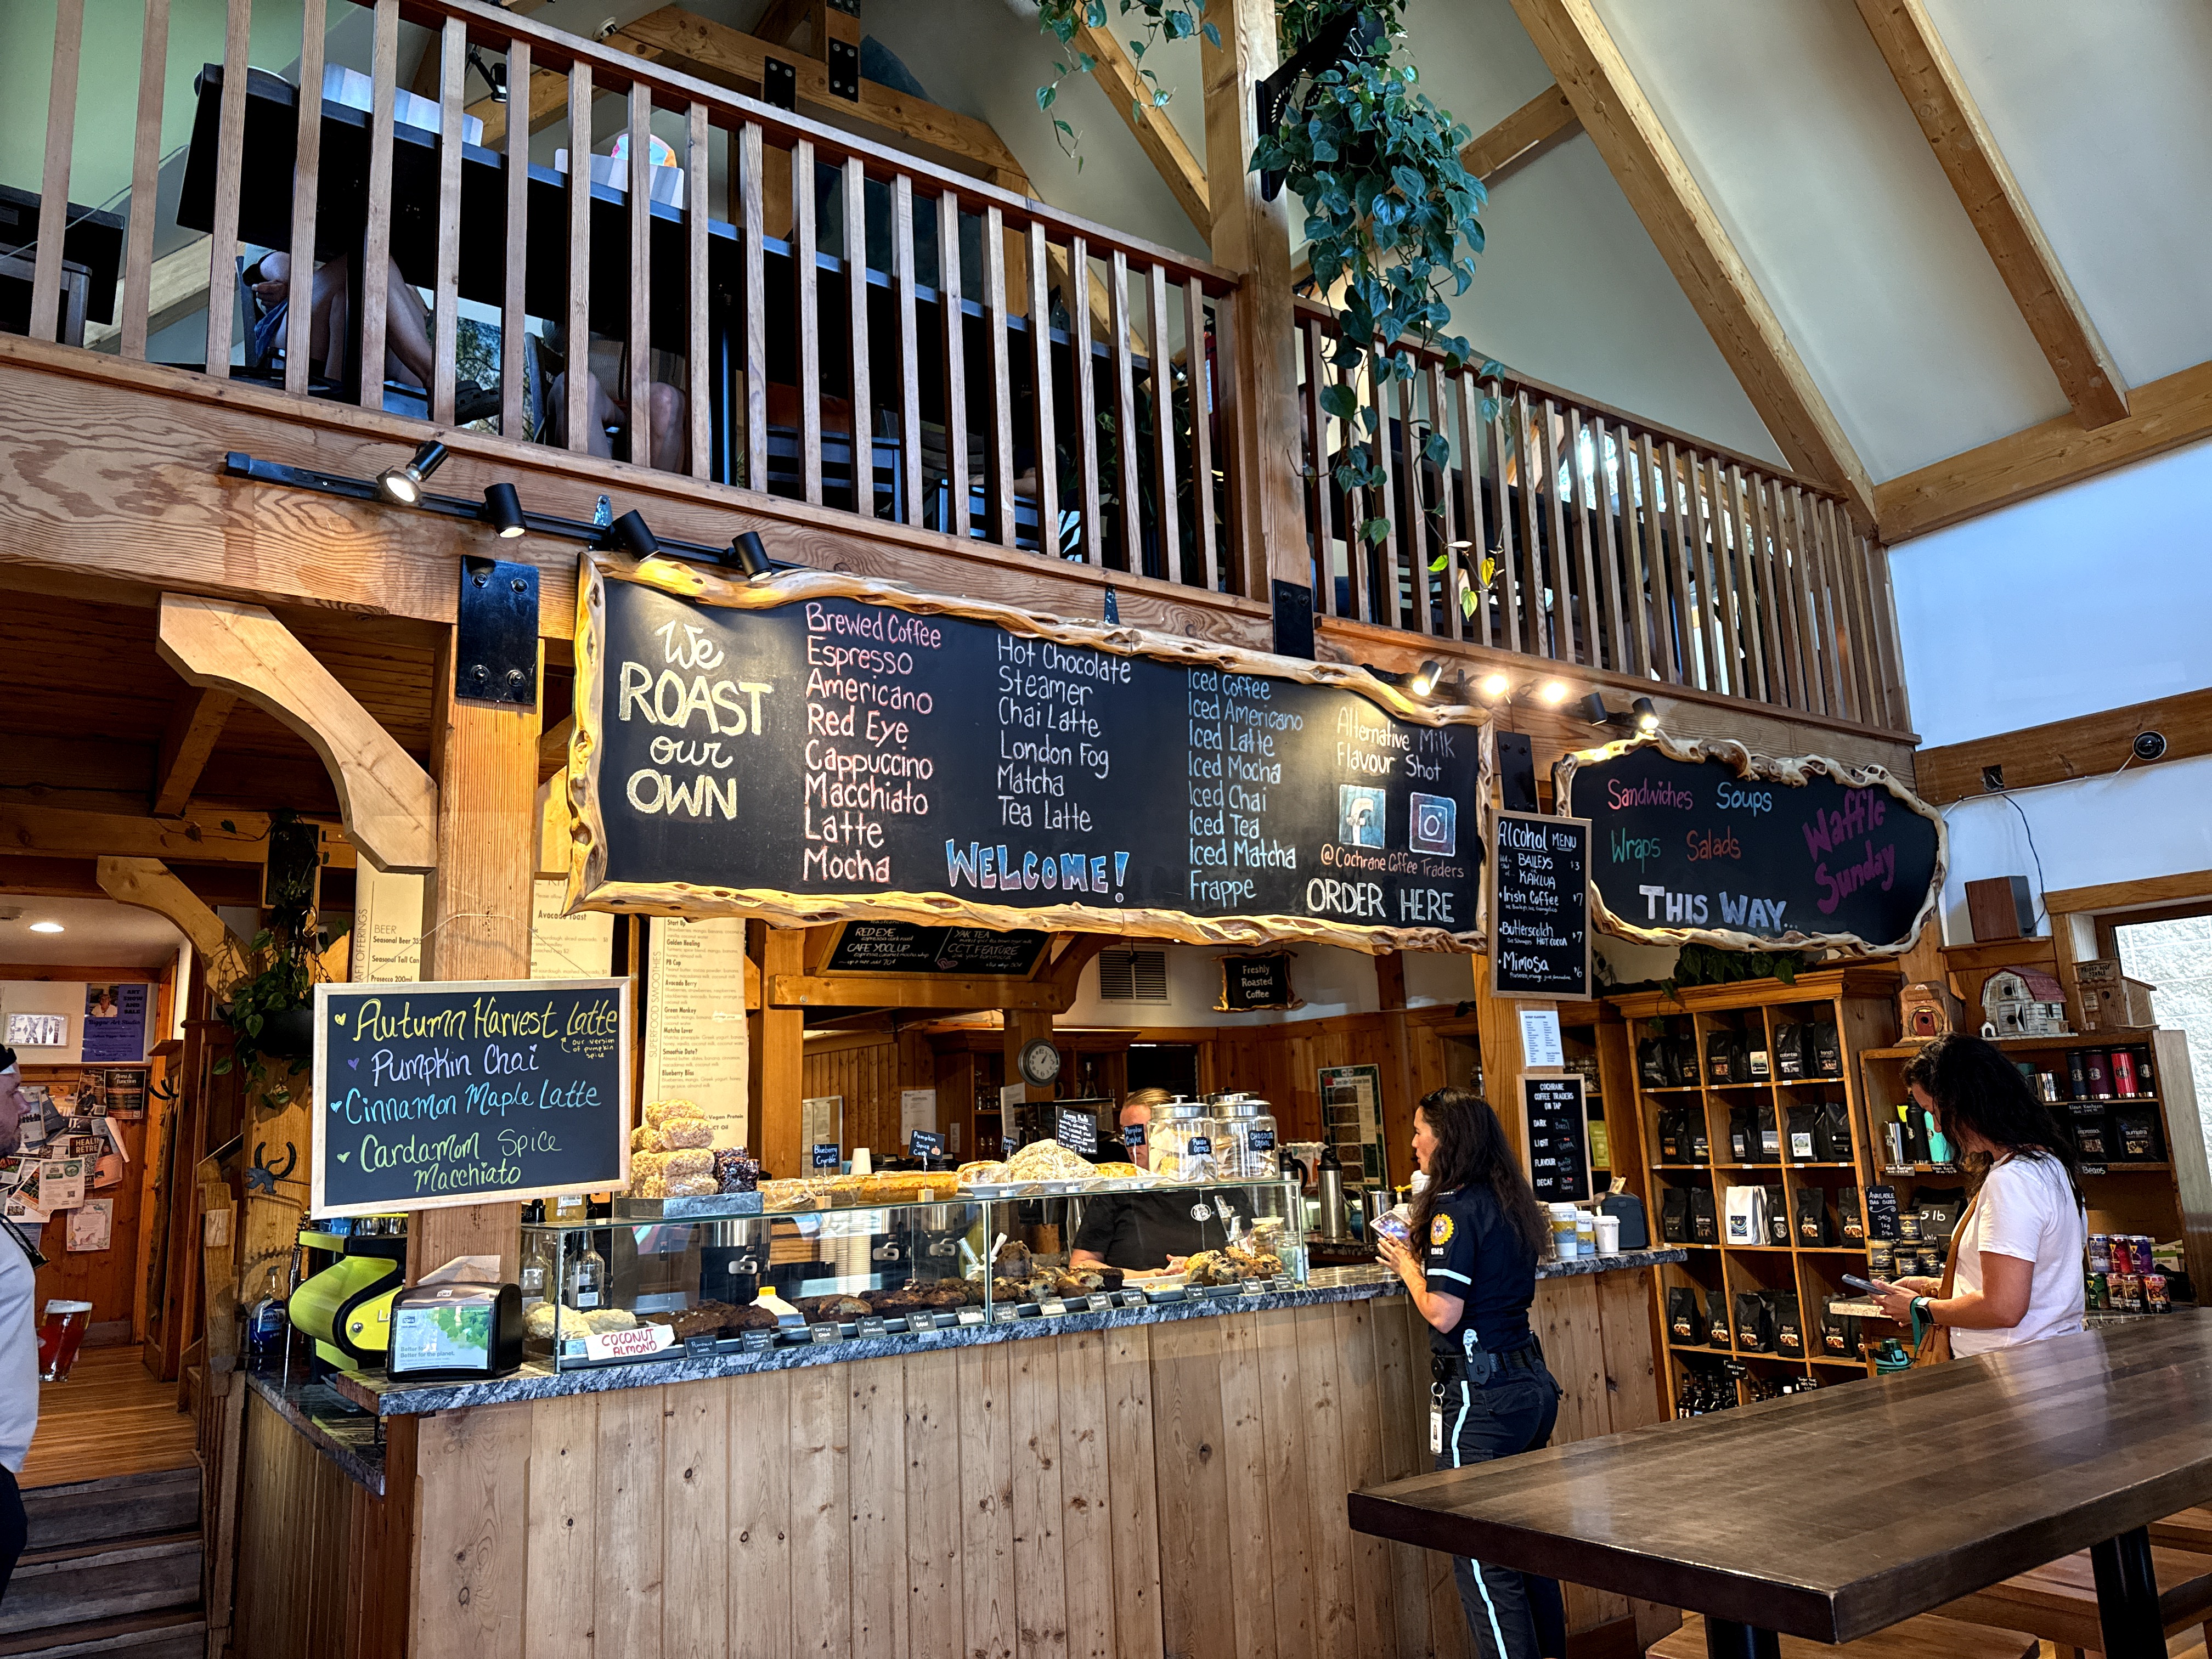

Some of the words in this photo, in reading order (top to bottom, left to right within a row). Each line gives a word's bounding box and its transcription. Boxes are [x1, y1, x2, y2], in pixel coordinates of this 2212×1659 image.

[806, 602, 883, 637] Brewed
[888, 613, 941, 649] Coffee
[656, 620, 724, 670] We
[807, 636, 913, 675] Espresso
[997, 634, 1035, 668] Hot
[1043, 643, 1131, 685] Chocolate
[619, 661, 772, 736] ROAST
[806, 668, 933, 715] Americano
[999, 667, 1093, 707] Steamer
[1187, 668, 1217, 691] Iced
[1223, 675, 1272, 701] Coffee
[808, 703, 854, 737] Red
[867, 710, 909, 748] Eye
[998, 697, 1041, 727] Chai
[1048, 703, 1102, 737] Latte
[1188, 692, 1220, 719] Iced
[1224, 697, 1303, 731] Americano
[1188, 719, 1222, 752] Iced
[1230, 724, 1276, 758] Latte
[1338, 706, 1410, 751] Alternative
[1419, 730, 1456, 759] Milk
[650, 735, 733, 769] our
[805, 742, 933, 785] Cappuccino
[1000, 730, 1072, 767] London
[1080, 743, 1109, 780] Fog
[1188, 751, 1222, 778] Iced
[1228, 755, 1282, 785] Mocha
[1337, 742, 1395, 774] Flavour
[1406, 754, 1441, 781] Shot
[627, 769, 737, 820] OWN
[805, 774, 929, 815] Macchiato
[997, 763, 1064, 797] Matcha
[1188, 781, 1224, 808] Iced
[1229, 785, 1267, 812] Chai
[997, 795, 1032, 828] Tea
[1044, 800, 1093, 833] Latte
[1607, 778, 1694, 811] Sandwiches
[1716, 782, 1772, 817] Soups
[805, 808, 882, 848] Latte
[1189, 809, 1224, 836] Iced
[1230, 813, 1260, 839] Tea
[1498, 821, 1548, 851] Alcohol
[1552, 832, 1576, 849] MENU
[1803, 788, 1886, 862] Waffle
[804, 848, 890, 883] Mocha
[1189, 837, 1227, 866] Iced
[1233, 838, 1296, 870] Matcha
[1321, 842, 1386, 870] @Cochrane
[1389, 855, 1418, 874] Coffee
[1420, 858, 1465, 878] Traders
[1517, 853, 1553, 870] BAILEYS
[1570, 860, 1580, 871] $3
[1611, 828, 1660, 873] Wraps
[1686, 826, 1741, 862] Salads
[945, 838, 1130, 903] WELCOME!
[1519, 869, 1555, 890] KAHLUA
[1815, 840, 1895, 914] Sunday
[1189, 869, 1257, 908] Frappe
[1307, 878, 1385, 917] ORDER
[1400, 889, 1454, 923] HERE
[1504, 885, 1526, 904] Irish
[1530, 890, 1559, 906] Coffee
[1573, 893, 1583, 907] $7
[1639, 884, 1708, 924] THIS
[1718, 891, 1798, 932] WAY...
[356, 909, 368, 962] OFFERINGS
[373, 935, 397, 944] Seasonal
[374, 925, 397, 934] BEER
[684, 939, 700, 947] Healing
[855, 927, 874, 936] RED
[876, 928, 896, 936] EYE
[954, 930, 972, 938] YAK
[974, 930, 990, 939] TEA
[1502, 919, 1554, 937] Butterscotch
[1572, 931, 1583, 943] $7
[1536, 938, 1549, 946] HOT
[1550, 938, 1567, 947] COCOA
[847, 944, 872, 952] CAFE
[948, 943, 975, 953] CCT
[975, 945, 1021, 955] FEATURE
[651, 951, 661, 1003] SMOOTHIES
[1241, 977, 1273, 987] Roasted
[1243, 964, 1269, 975] Freshly
[1574, 966, 1582, 978] $6
[1246, 990, 1269, 998] Coffee
[9, 1016, 65, 1044] EXIT
[353, 998, 465, 1042] Autumn
[473, 996, 557, 1039] Harvest
[567, 1000, 617, 1036] Latte
[649, 1006, 659, 1058] SUPERFOOD
[371, 1047, 471, 1087] Pumpkin
[484, 1043, 538, 1075] Chai
[584, 1045, 613, 1053] pumpkin
[346, 1087, 456, 1124] Cinnamon
[465, 1082, 534, 1116] Maple
[539, 1079, 601, 1110] Latte
[1544, 1102, 1551, 1110] ON
[69, 1118, 81, 1128] IT.
[913, 1131, 936, 1142] Pumpkin
[360, 1132, 479, 1173] Cardamom
[498, 1127, 562, 1158] Spice
[814, 1145, 837, 1156] Blueberry
[916, 1141, 930, 1150] Spice
[1534, 1138, 1548, 1147] LIGHT
[414, 1158, 521, 1193] Macchiato
[1534, 1158, 1556, 1167] FLAVOUR
[2081, 1166, 2106, 1175] Beans
[1537, 1178, 1553, 1187] DECAF
[1920, 1210, 1929, 1221] 5
[1932, 1210, 1946, 1221] lb
[1431, 1247, 1444, 1255] EMS
[601, 1329, 654, 1347] COCONUT
[612, 1341, 657, 1357] ALMOND
